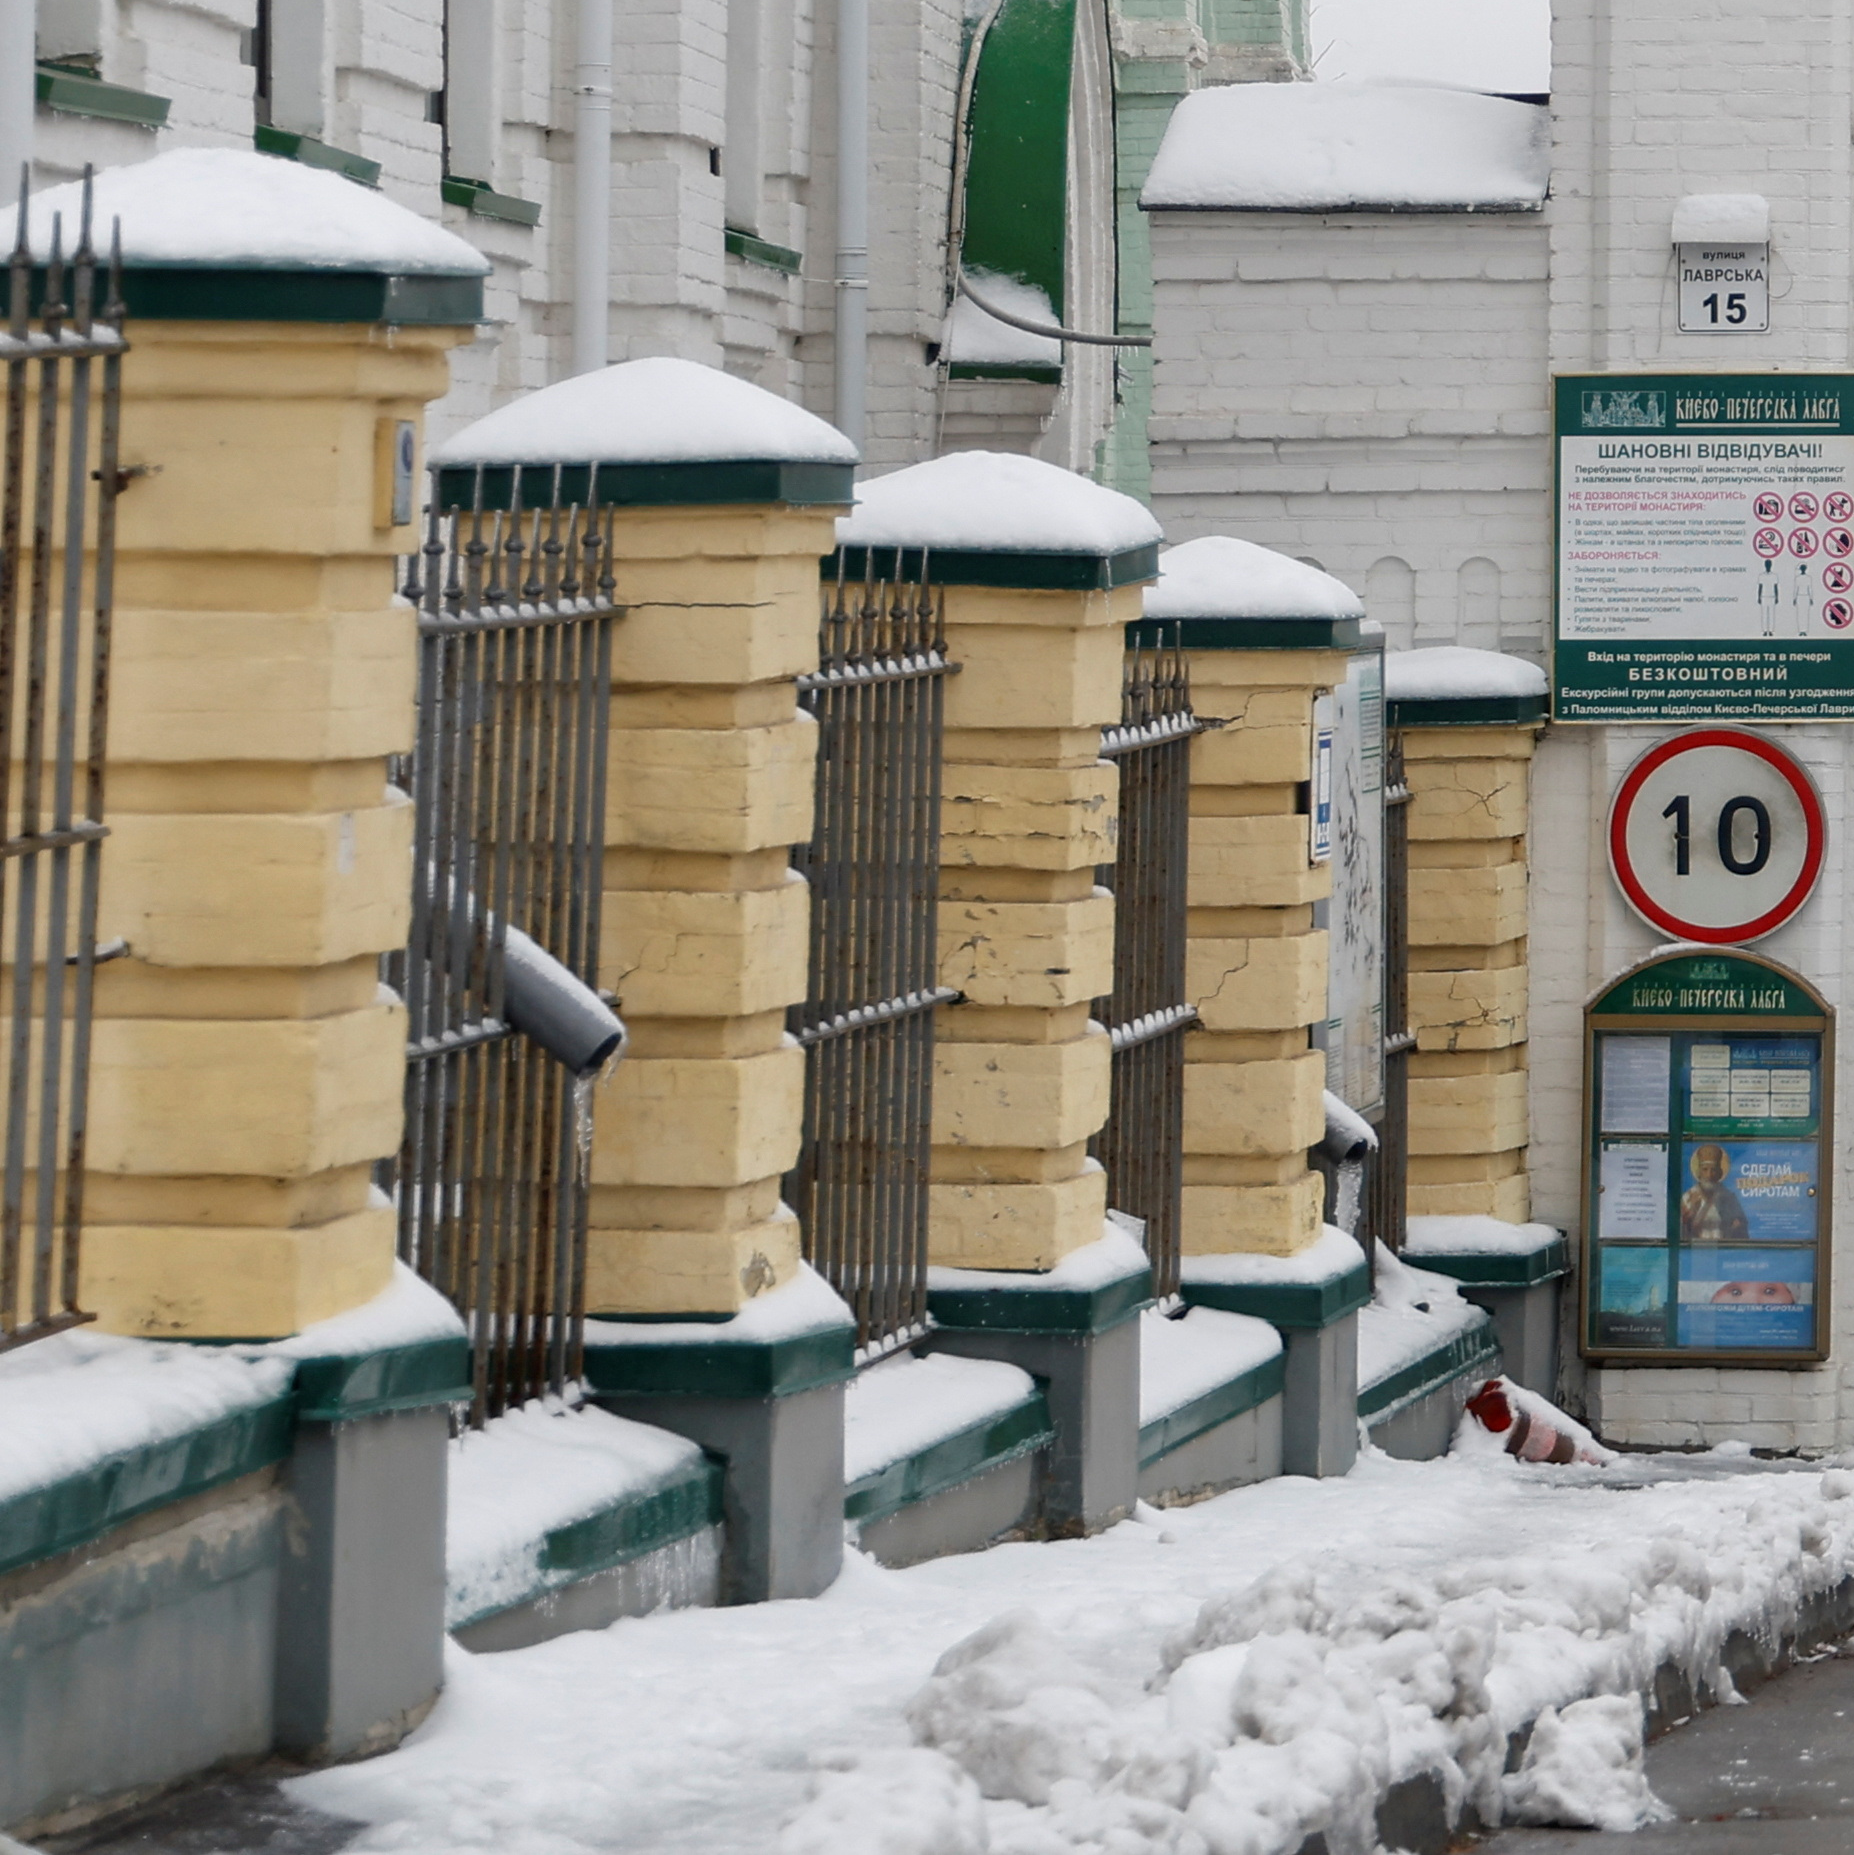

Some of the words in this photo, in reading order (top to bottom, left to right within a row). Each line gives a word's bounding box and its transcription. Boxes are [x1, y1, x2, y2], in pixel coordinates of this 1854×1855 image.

[1703, 252, 1745, 261] вулиця
[1683, 269, 1763, 281] ЛАВРСЬКА
[1703, 293, 1746, 324] 15
[1676, 398, 1796, 419] КИЄВО-ПЕЧЕРСЬКА
[1803, 398, 1839, 419] ЛАВРА
[1599, 444, 1690, 458] ШАНОВНІ
[1698, 444, 1822, 461] ВІДВІДУВАЧІ!
[1575, 465, 1641, 475] Перебуваючи
[1659, 465, 1703, 474] території
[1764, 465, 1785, 474] слід
[1568, 492, 1581, 500] НЕ
[1584, 491, 1668, 501] ДОЗВОЛЯЄТЬСЯ
[1671, 491, 1746, 500] ЗНАХОДИТИСЬ
[1568, 503, 1582, 511] НА
[1585, 502, 1637, 511] ТЕРИТОРІЇ
[1588, 652, 1614, 663] Вхід
[1634, 652, 1694, 663] територію
[1697, 653, 1760, 663] монастиря
[1763, 653, 1776, 661] та
[1789, 653, 1831, 663] печери
[1629, 665, 1787, 681] БЕЗКОШТОВНИЙ
[1562, 687, 1628, 699] Екскурсійні
[1632, 690, 1665, 699] групи
[1667, 689, 1751, 699] допускаються
[1755, 687, 1786, 697] після
[1571, 704, 1658, 715] Паломницьким
[1661, 704, 1712, 715] відділом
[1715, 704, 1817, 715] Києво-Печерської
[1662, 796, 1772, 876] 10
[1751, 990, 1785, 1008] ЛАВРА
[1741, 1162, 1792, 1177] СДЕЛАЙ
[1736, 1172, 1809, 1190] ПОДАРОК
[1741, 1186, 1800, 1197] СИРОТАМ
